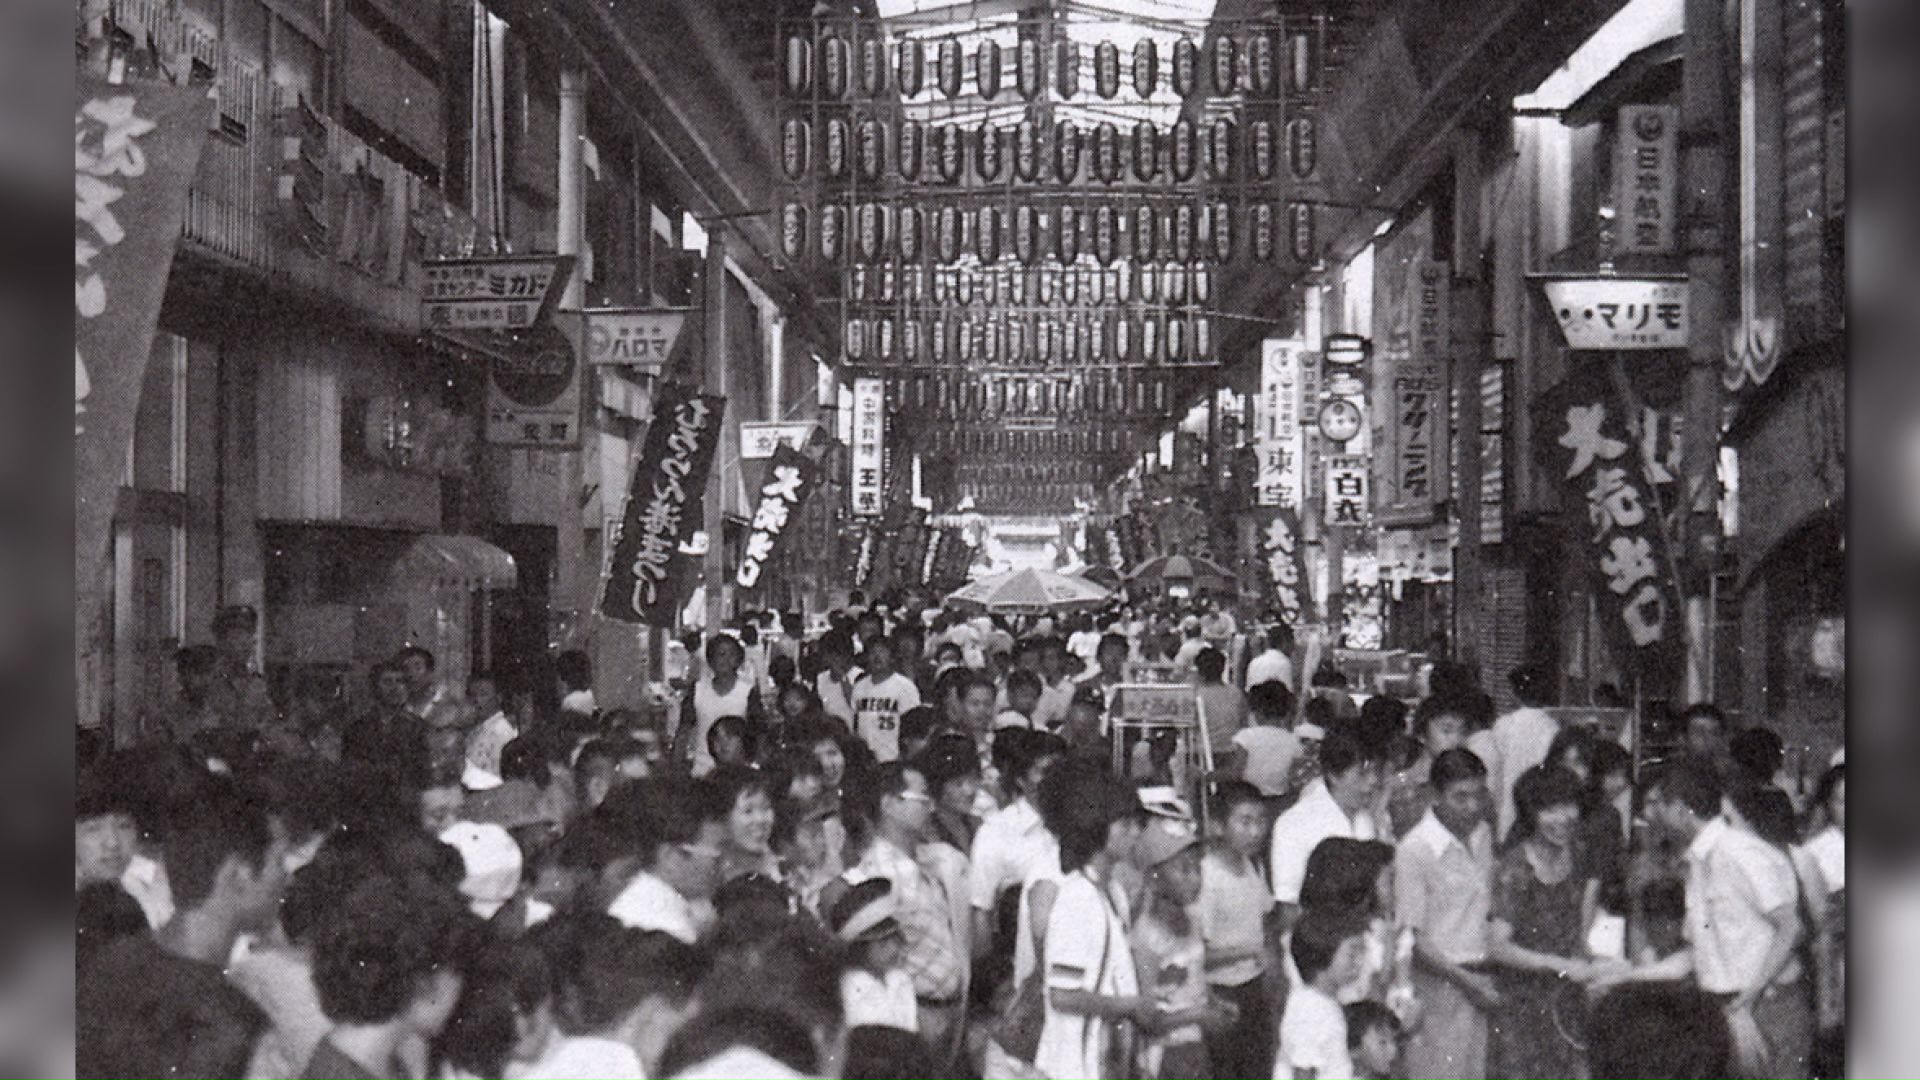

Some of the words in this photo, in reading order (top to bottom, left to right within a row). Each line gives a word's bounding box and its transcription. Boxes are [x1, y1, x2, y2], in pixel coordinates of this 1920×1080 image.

[488, 272, 548, 296] ミカド
[1597, 302, 1682, 330] マリモ
[879, 715, 896, 731] 25
